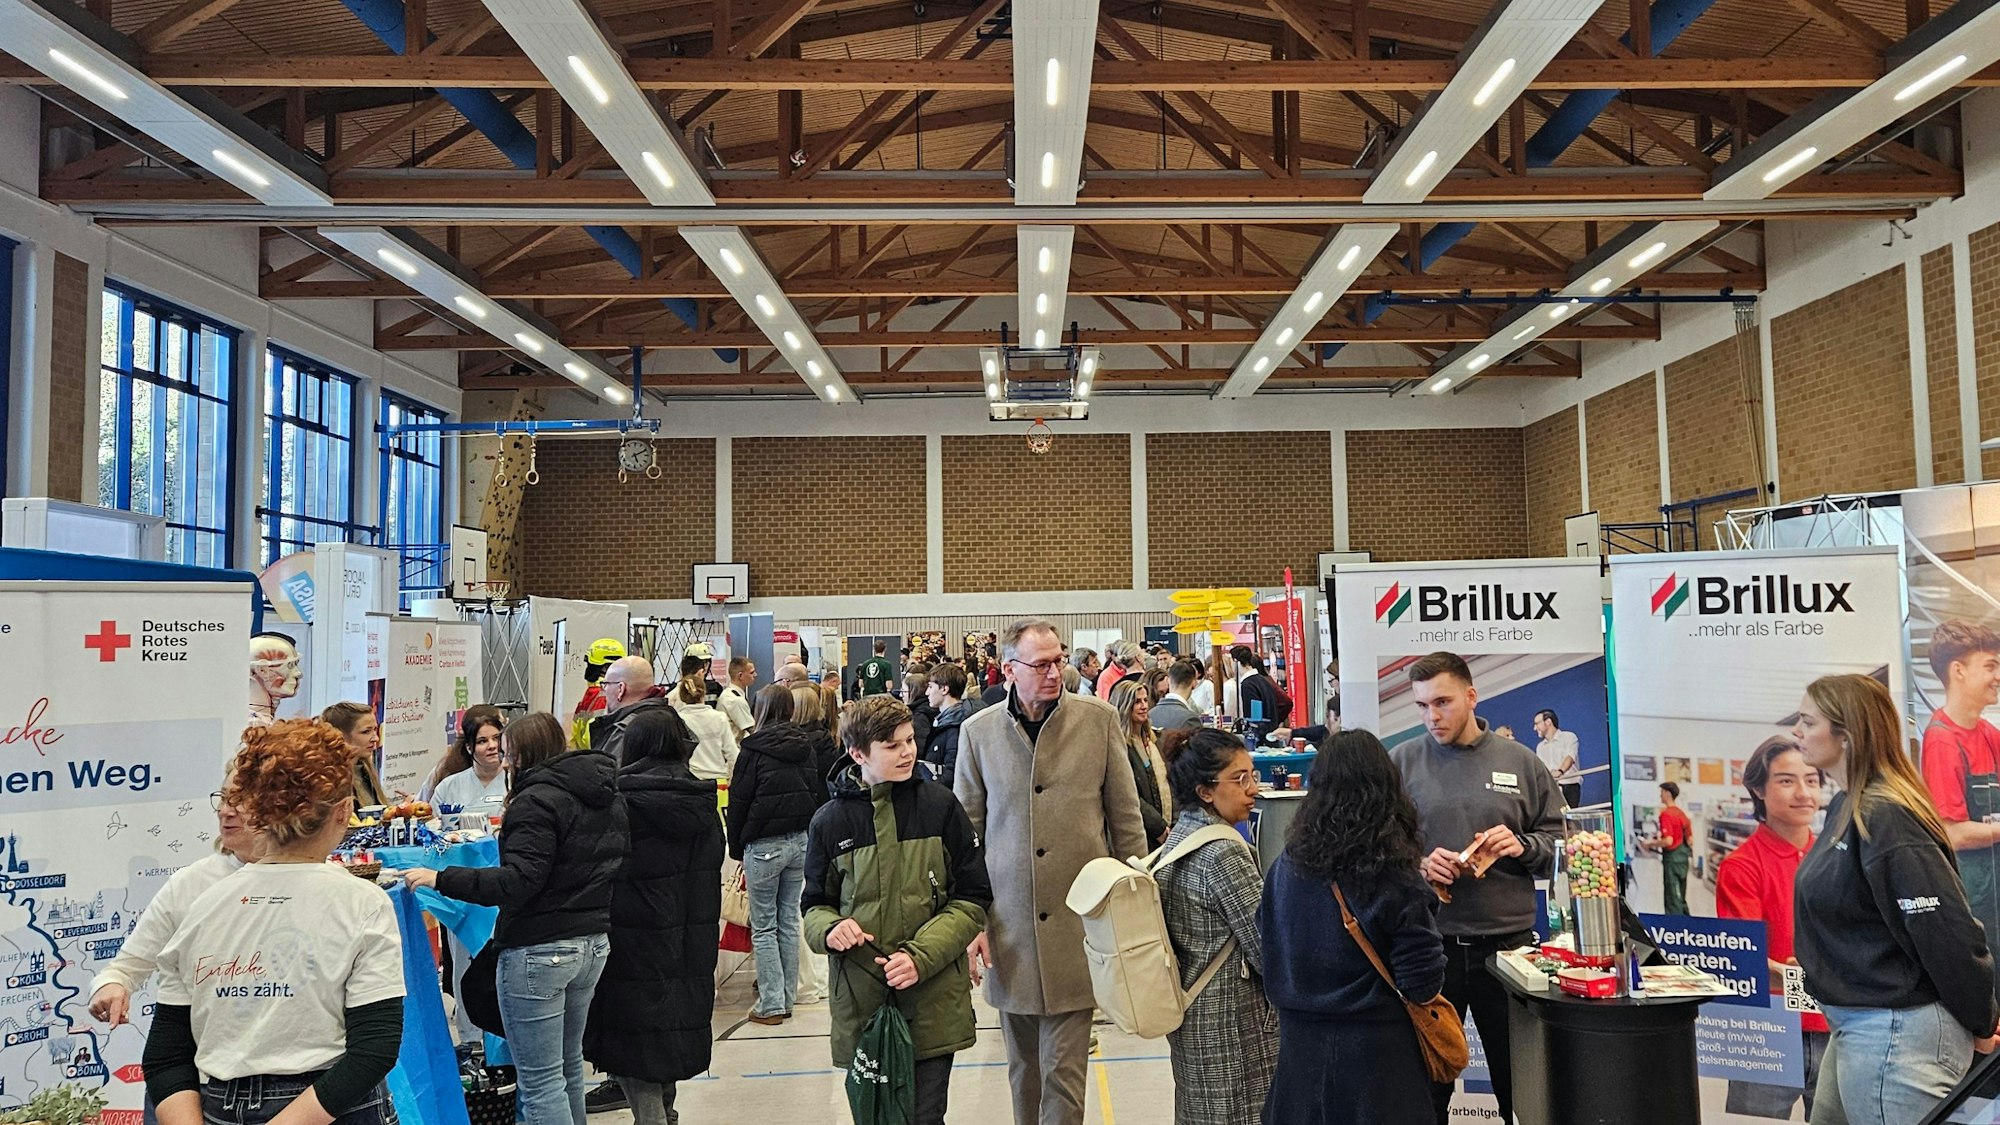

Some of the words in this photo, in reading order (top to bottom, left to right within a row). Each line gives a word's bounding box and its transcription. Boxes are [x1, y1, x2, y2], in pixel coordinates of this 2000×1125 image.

[1699, 574, 1855, 615] Brillux
[1419, 584, 1560, 622] Brillux
[142, 620, 225, 632] Deutsches
[1745, 621, 1769, 636] als
[1774, 620, 1824, 636] Farbe
[142, 635, 188, 647] Rotes
[1462, 628, 1485, 642] als
[1488, 626, 1533, 641] Farbe
[539, 635, 570, 655] Feuehr
[142, 649, 187, 661] Kreuz
[405, 654, 432, 665] AKADEMIE
[0, 770, 53, 794] en
[67, 759, 161, 791] Weg.
[1904, 896, 1940, 910] Brillux
[1651, 926, 1758, 951] Verkaufen.
[216, 986, 249, 997] was
[1730, 1018, 1747, 1029] bei
[1750, 1020, 1787, 1033] Brillux:
[1727, 1032, 1766, 1046] (m/w/d)
[1697, 1041, 1726, 1053] Groß-
[1728, 1047, 1748, 1055] und
[1750, 1048, 1786, 1059] Außen-
[76, 1064, 104, 1077] BONN
